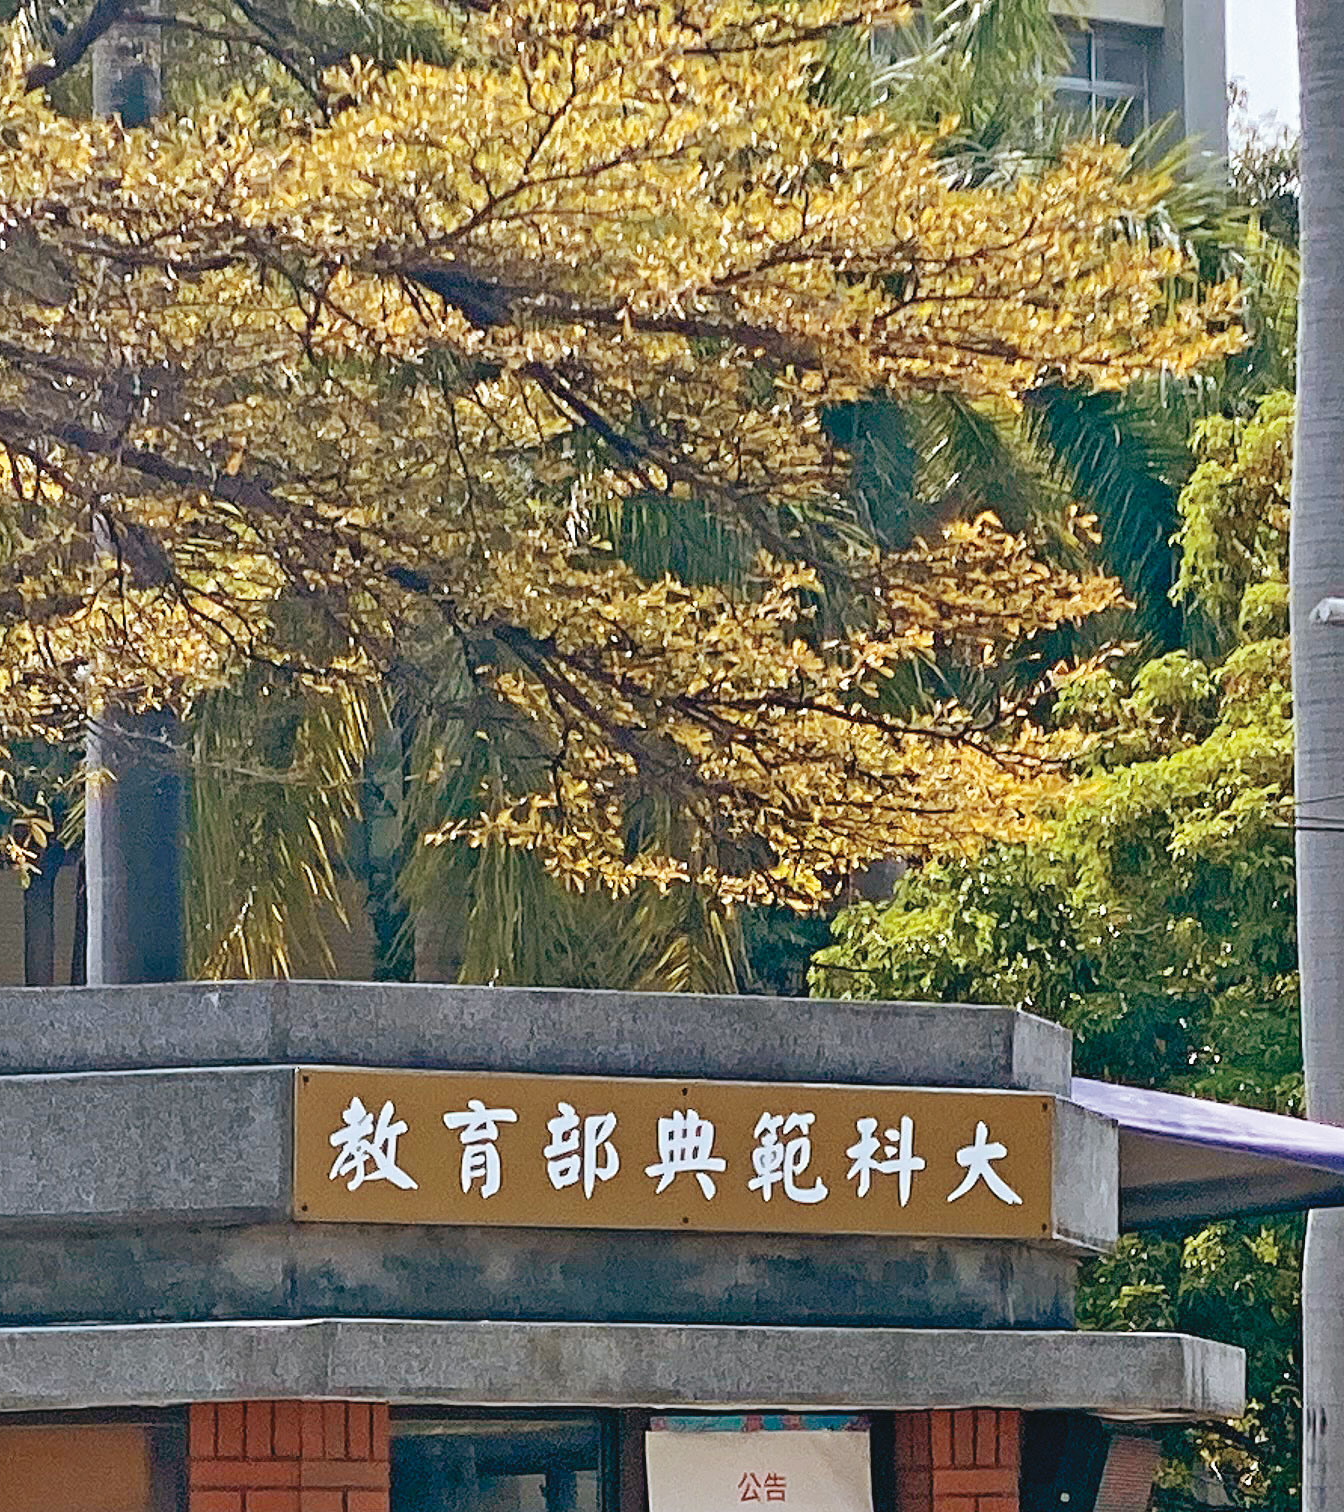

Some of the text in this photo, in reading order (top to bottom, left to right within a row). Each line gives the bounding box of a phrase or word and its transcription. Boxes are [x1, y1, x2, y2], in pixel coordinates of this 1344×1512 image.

[328, 1096, 1023, 1206] 教育部典範科大
[737, 1472, 787, 1503] 公告
